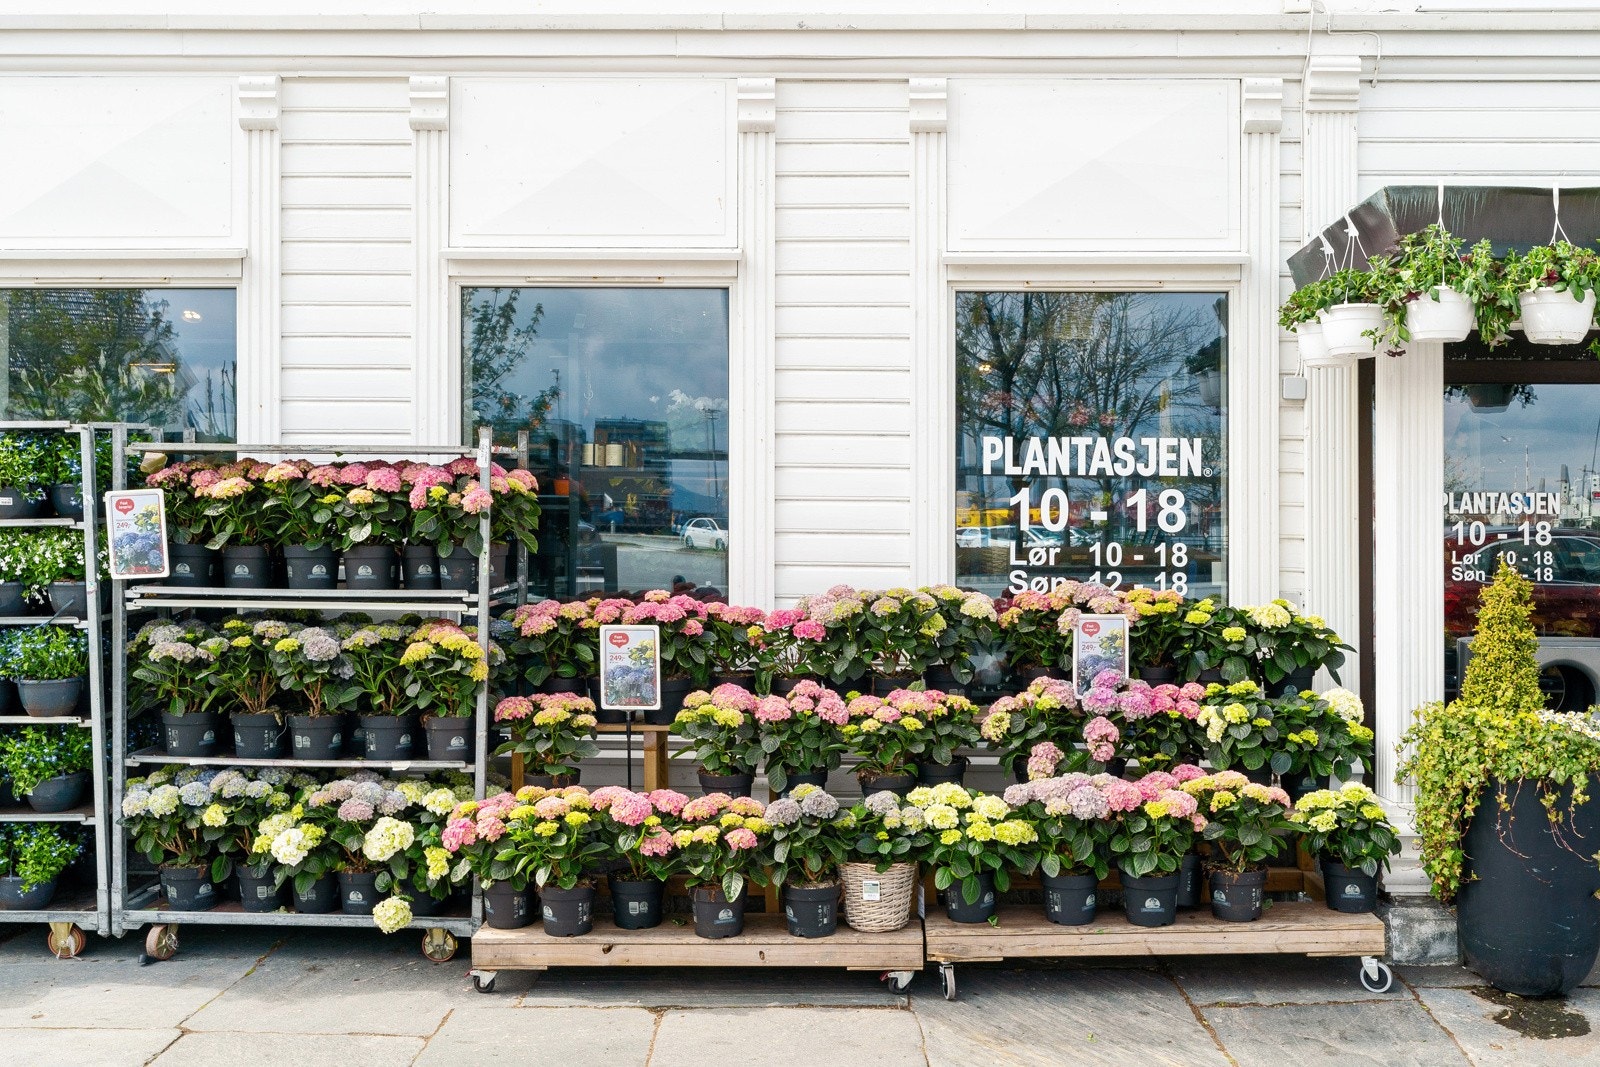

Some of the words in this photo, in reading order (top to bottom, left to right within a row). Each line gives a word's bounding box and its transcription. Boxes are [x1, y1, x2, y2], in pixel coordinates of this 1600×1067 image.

[1009, 487, 1070, 532] 10
[1090, 510, 1108, 521] -
[1126, 488, 1188, 533] 18
[1452, 520, 1486, 546] 10
[1517, 520, 1552, 546] 18
[1009, 542, 1061, 567] Lør
[1088, 542, 1122, 567] 10
[1154, 542, 1188, 567] 18
[1451, 550, 1482, 565] Lør
[1496, 550, 1517, 565] 10
[1533, 550, 1553, 565] 18
[1154, 571, 1188, 597] 18
[1451, 567, 1486, 581] Søn
[1533, 567, 1553, 582] 18
